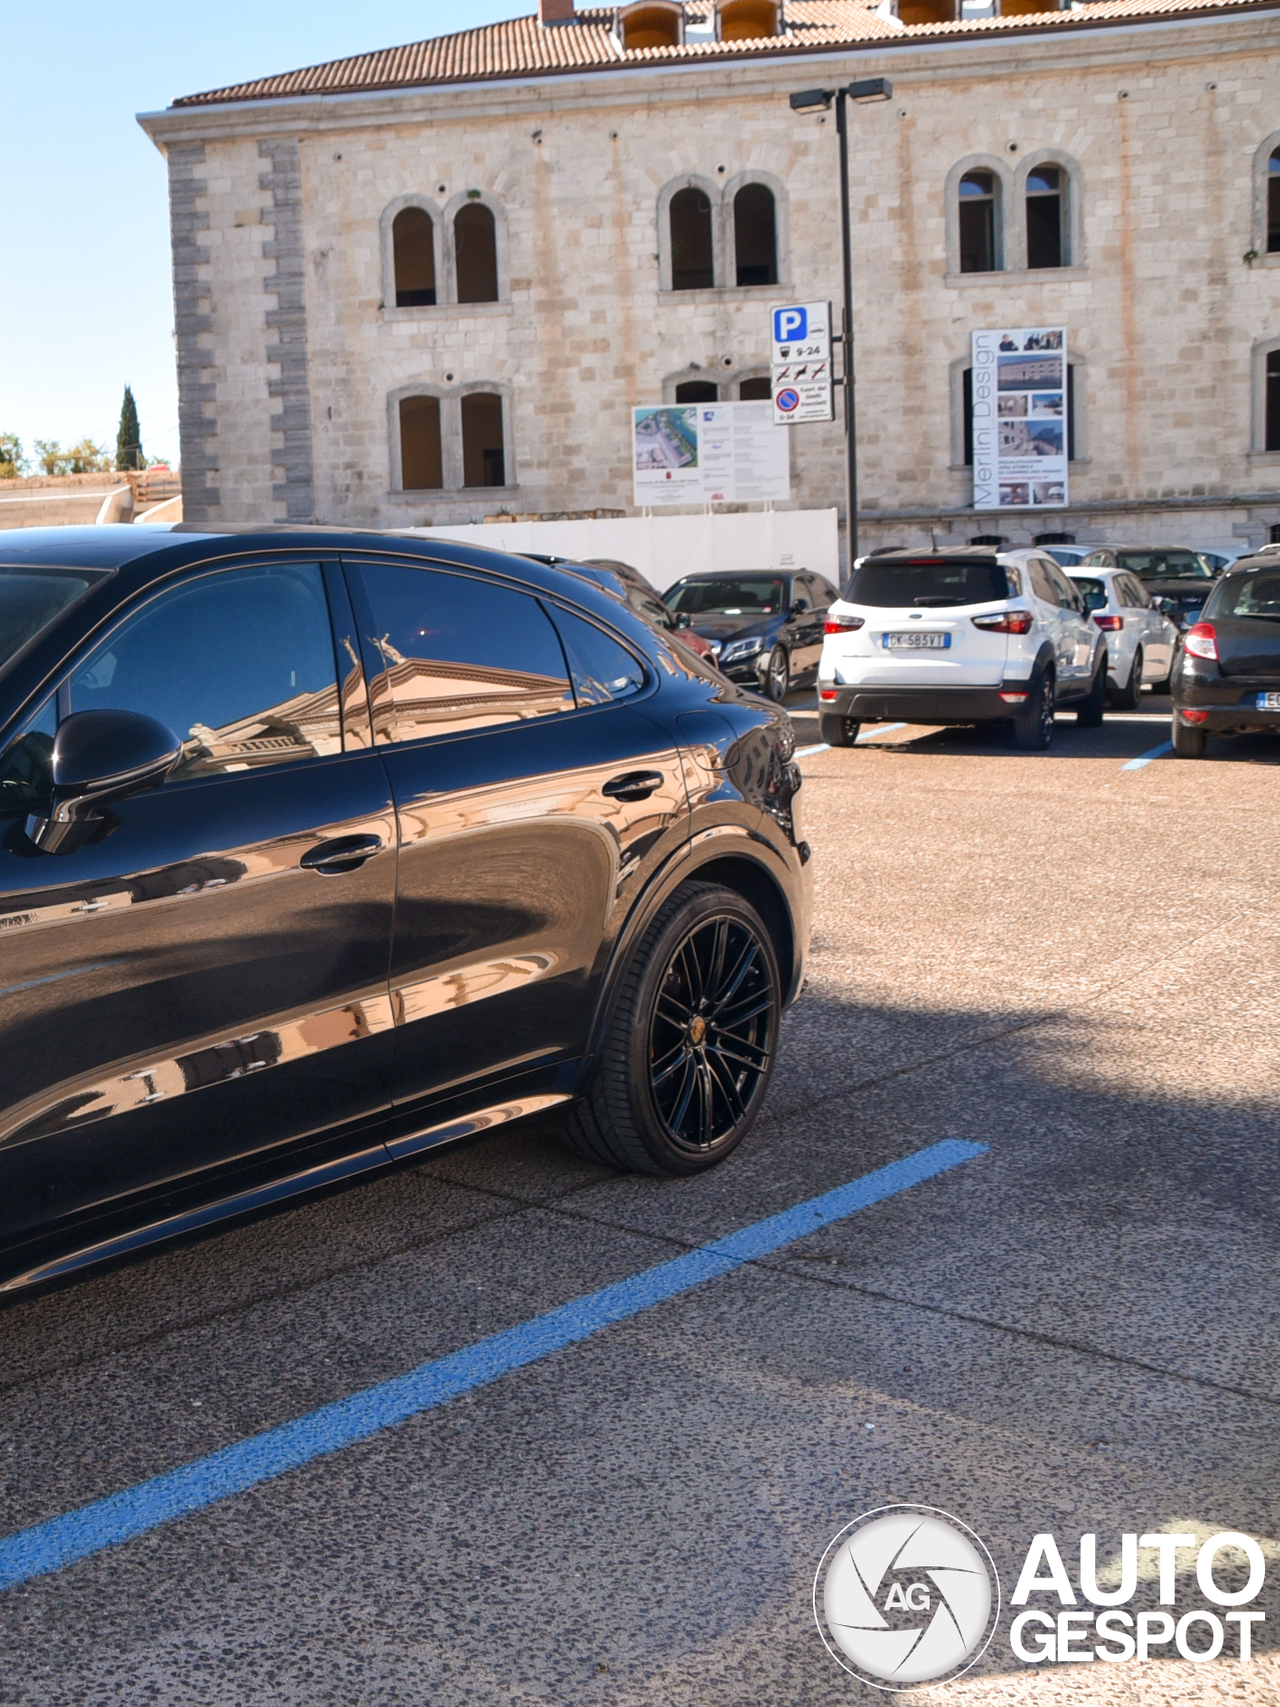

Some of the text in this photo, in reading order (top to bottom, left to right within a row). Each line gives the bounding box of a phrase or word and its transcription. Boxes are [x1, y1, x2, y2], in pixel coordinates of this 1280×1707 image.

[780, 310, 801, 340] P
[796, 345, 821, 357] 9-24
[973, 334, 995, 505] Merlini Design
[907, 634, 943, 646] 583VT
